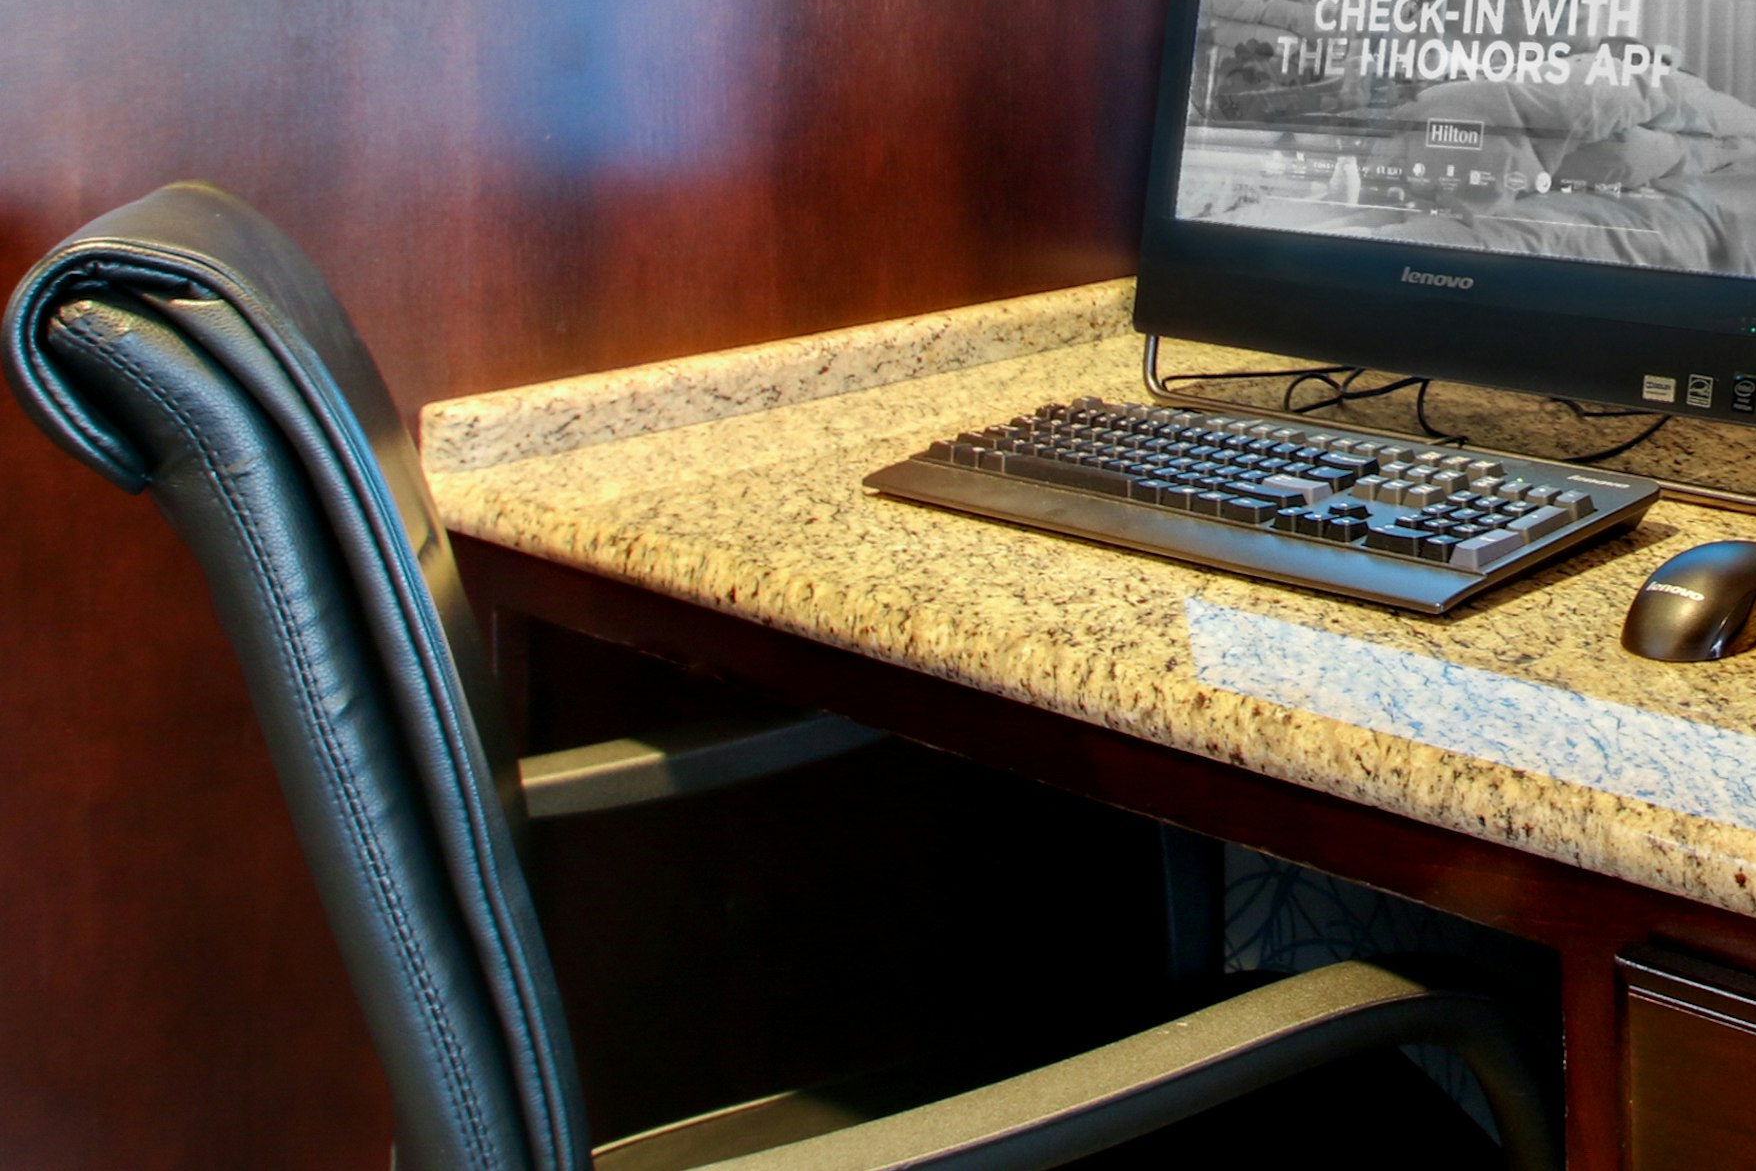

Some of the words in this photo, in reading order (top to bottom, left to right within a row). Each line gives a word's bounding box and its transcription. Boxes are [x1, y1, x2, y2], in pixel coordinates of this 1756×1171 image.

[1277, 36, 1348, 76] THE
[1360, 37, 1572, 85] HHONORS
[1431, 124, 1479, 145] Hilton
[1401, 266, 1475, 290] lenovo
[1646, 581, 1705, 602] lenovo
